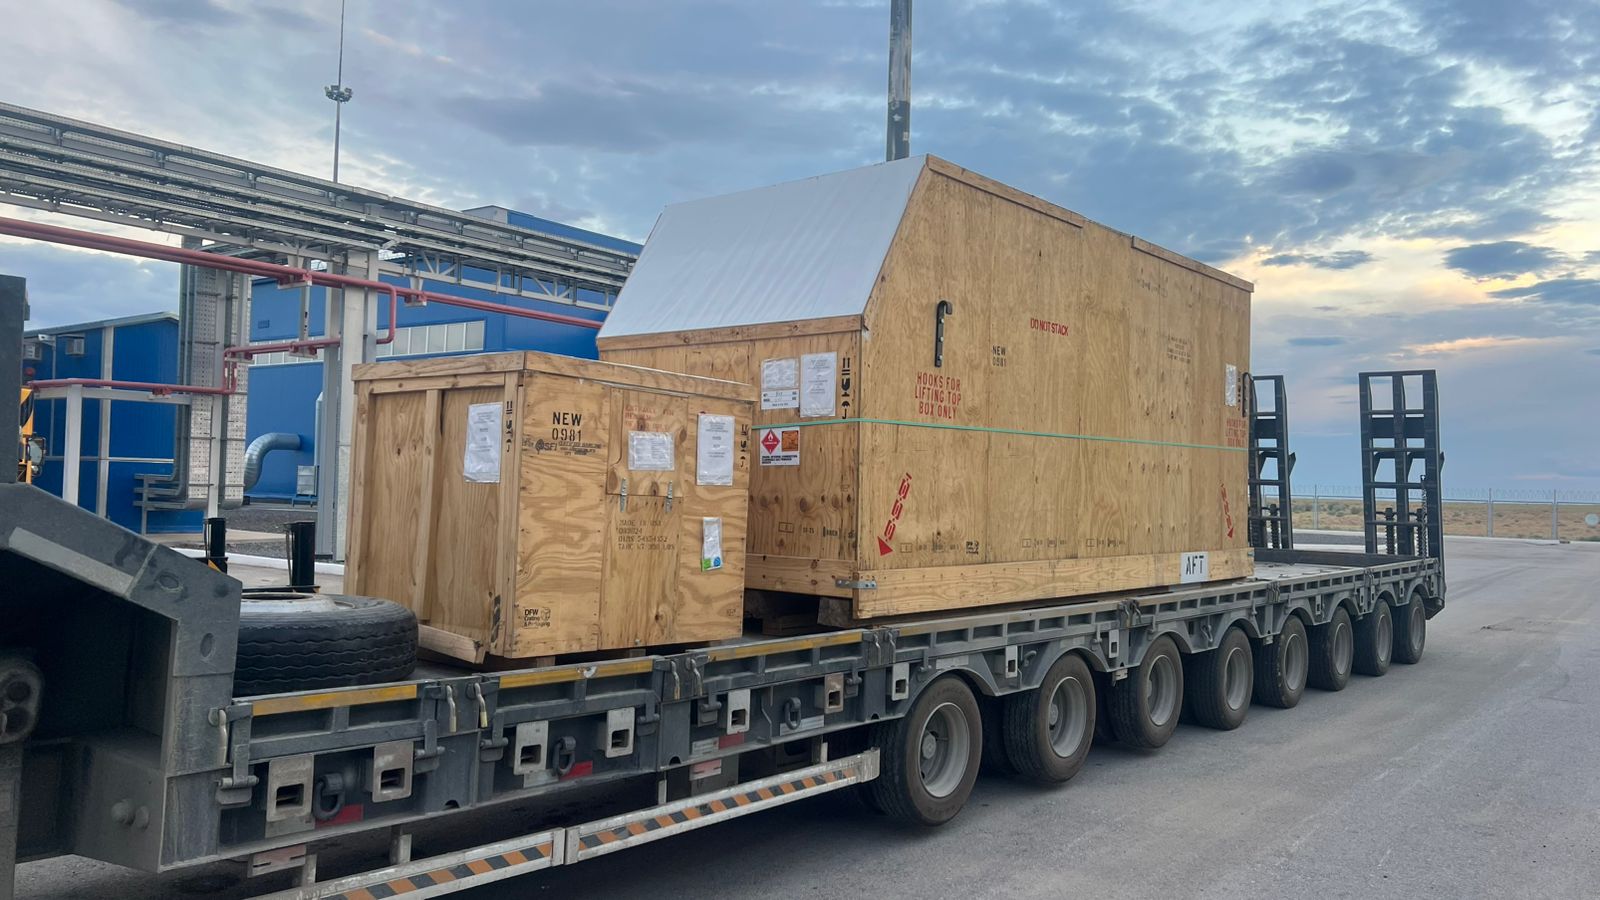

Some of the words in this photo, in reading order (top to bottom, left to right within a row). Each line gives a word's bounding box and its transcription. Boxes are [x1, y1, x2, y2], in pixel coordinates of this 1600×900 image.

[1030, 318, 1039, 330] DO
[1051, 322, 1069, 337] STACK
[992, 345, 1006, 356] NEW
[917, 371, 944, 388] HOOKS
[946, 376, 961, 391] FOR
[914, 385, 945, 403] LIFTING
[947, 391, 961, 406] TOP
[552, 411, 583, 427] NEW
[918, 401, 934, 417] BOX
[937, 405, 958, 420] ONLY
[551, 427, 582, 442] 0981
[1185, 555, 1205, 575] AFT
[524, 608, 539, 616] DFW
